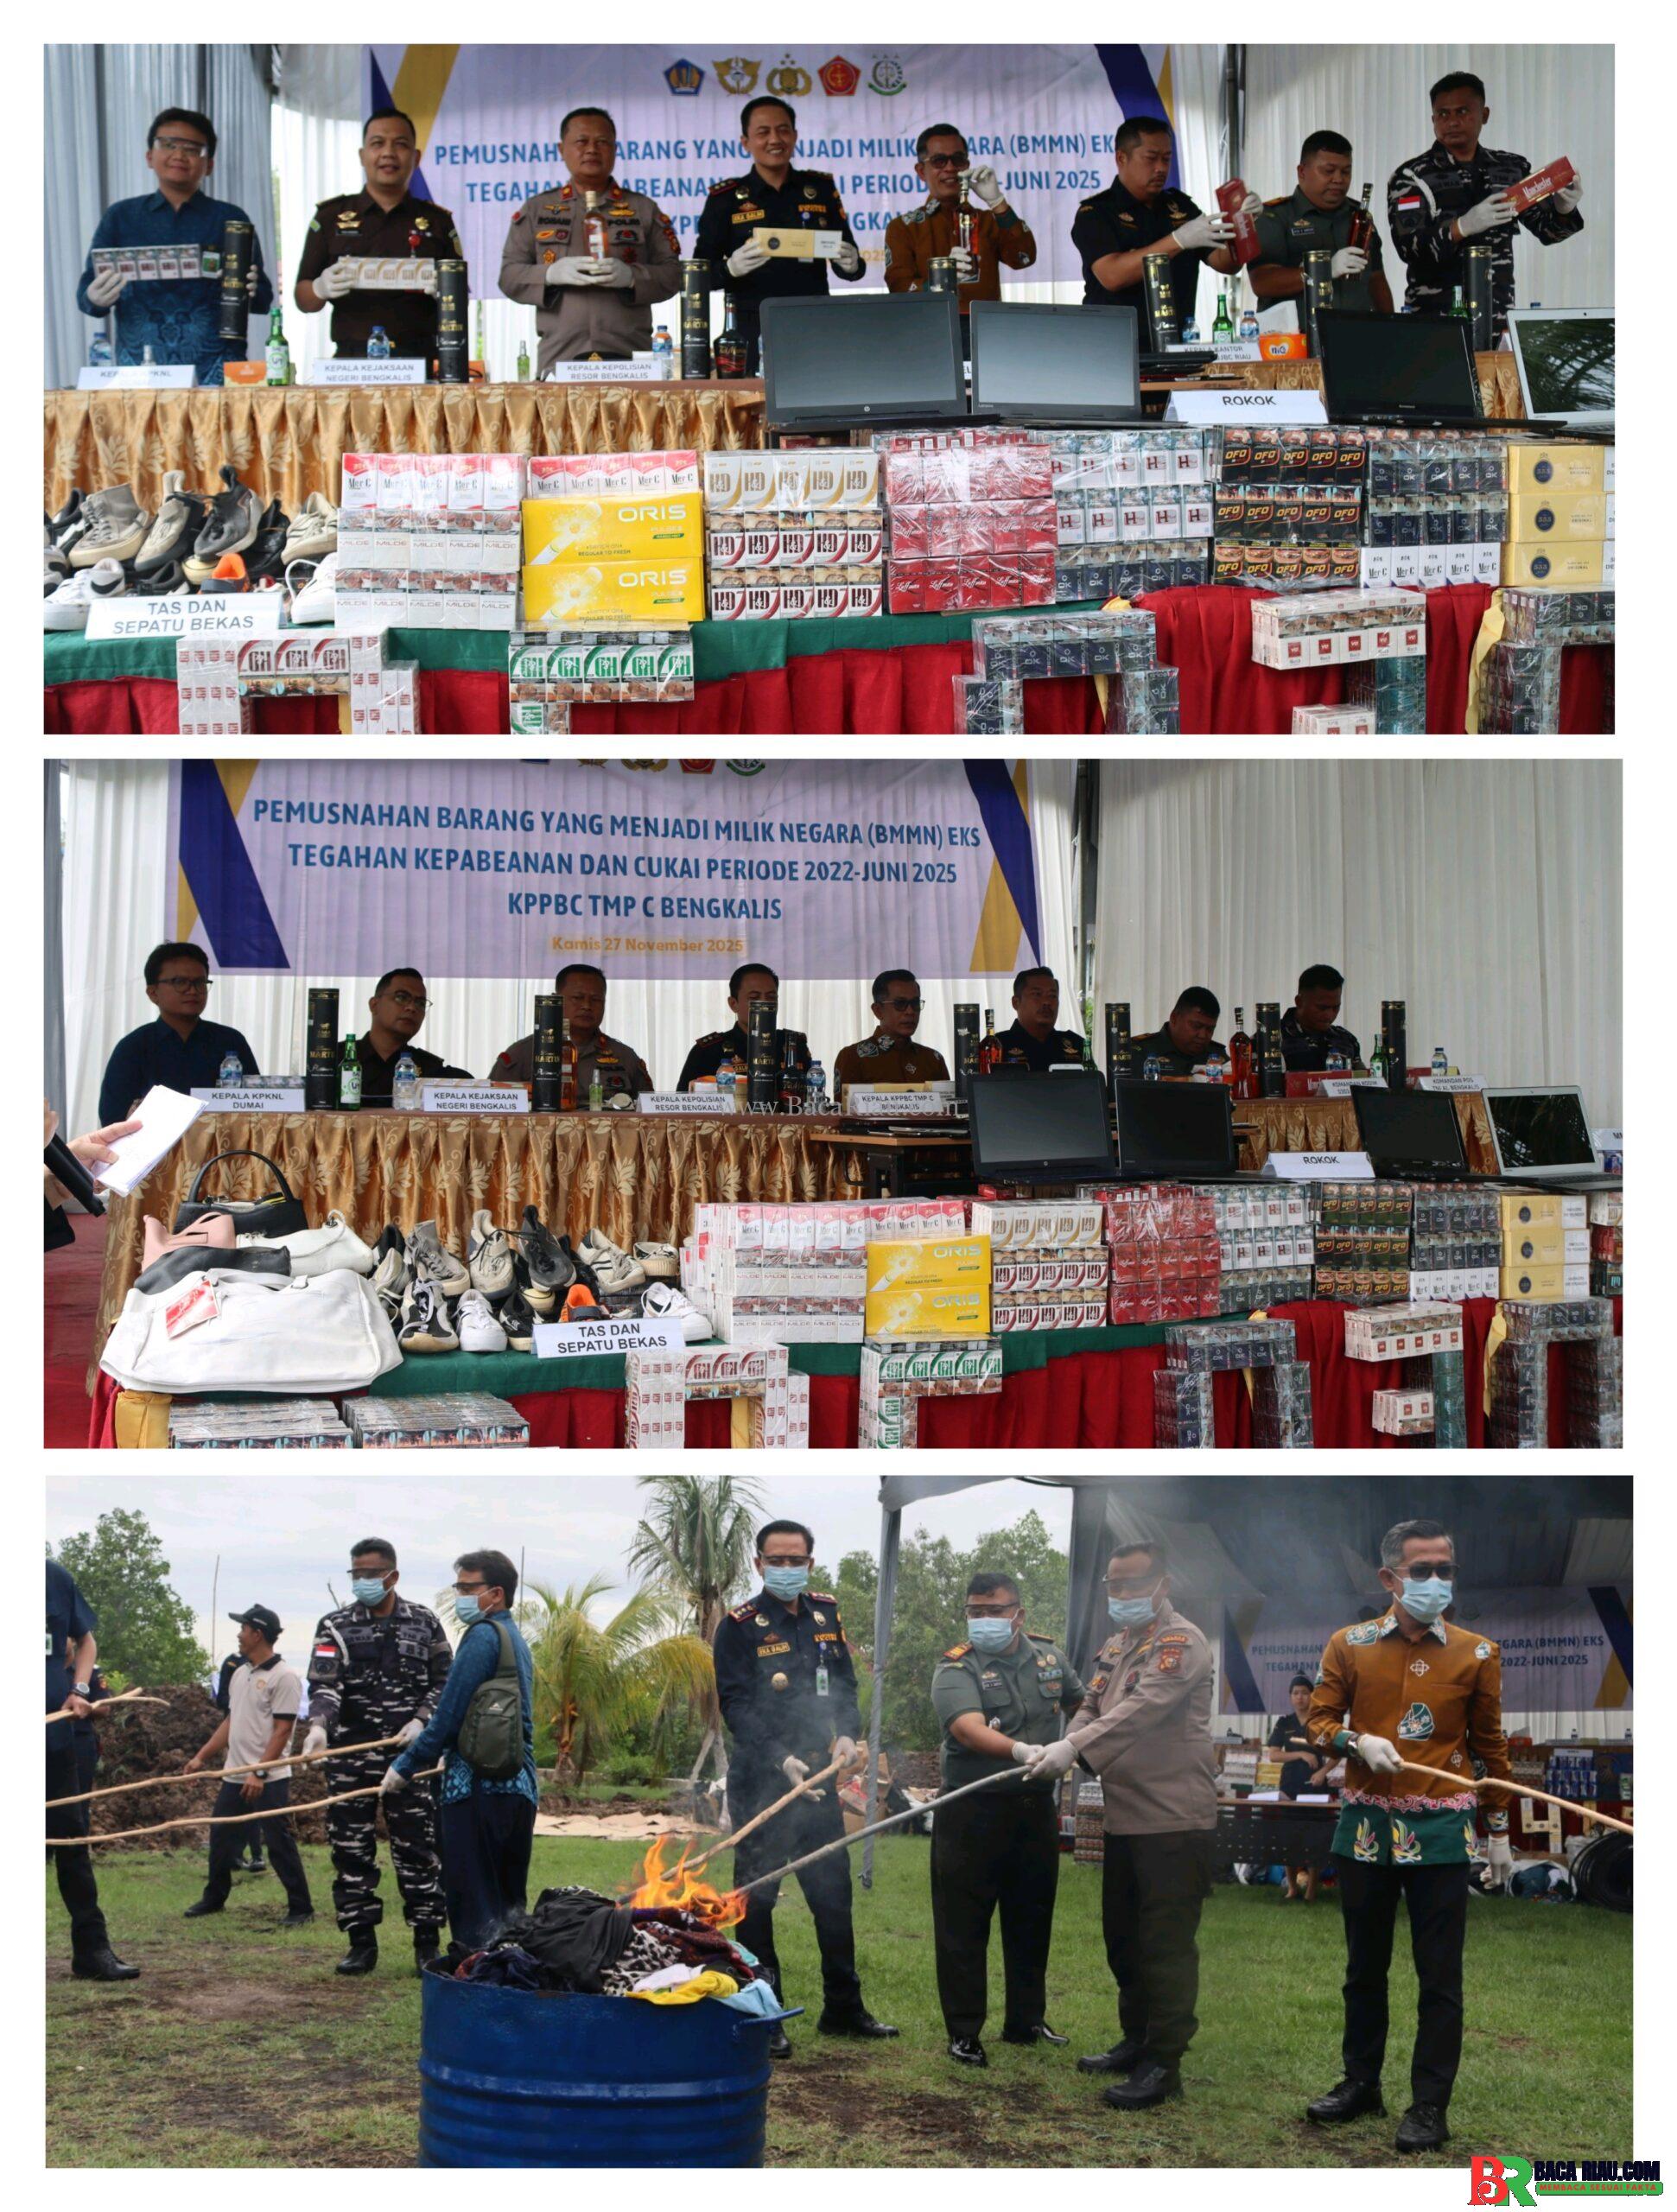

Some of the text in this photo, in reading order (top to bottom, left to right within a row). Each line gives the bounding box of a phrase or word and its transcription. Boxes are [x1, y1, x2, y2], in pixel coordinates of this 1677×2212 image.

[435, 142, 563, 165] PEMUSNAH
[614, 139, 687, 161] ARANG
[791, 138, 852, 159] NJADI
[860, 136, 917, 158] MILIK
[968, 136, 1005, 156] ARA
[1010, 133, 1086, 158] (BMMN)
[1091, 135, 1115, 153] EK
[852, 174, 929, 195] PERIOD
[997, 171, 1051, 191] -JUNI
[1056, 171, 1101, 189] 2025
[1222, 395, 1277, 406] ROKOK
[618, 504, 687, 523] ORIS
[619, 569, 688, 588] ORIS
[148, 600, 226, 615] TAS DAN
[113, 615, 254, 634] SEPATU BEKAS
[254, 799, 981, 851] PEMUSNAHAN BARANG YANG MENJADI MILIK NEGARA (BMMN) EKS
[288, 843, 957, 884] TEGAHAN KEPABEANAN DAN CUKAI PERIODE 2022-JUNI 2025
[509, 893, 782, 920] KPPBC TMP C BENGKALIS
[552, 937, 744, 953] Kamis 27 November 2025
[436, 1102, 517, 1110] NEGERI BENGKALIS
[681, 1103, 724, 1112] BENGKALIS
[1303, 1155, 1339, 1165] ROKOK
[933, 1244, 981, 1259] ORIS
[932, 1292, 981, 1307] ORIS
[578, 1323, 640, 1337] TAS DAN
[557, 1336, 668, 1354] SEPATU BEKAS
[1497, 1635, 1604, 1650] EGARA (BMMN) EKS
[1251, 1645, 1322, 1656] PEMUSNAHAN
[1265, 1661, 1315, 1672] TEGAHAN
[1500, 1654, 1588, 1668] 2022-JUNI 2025
